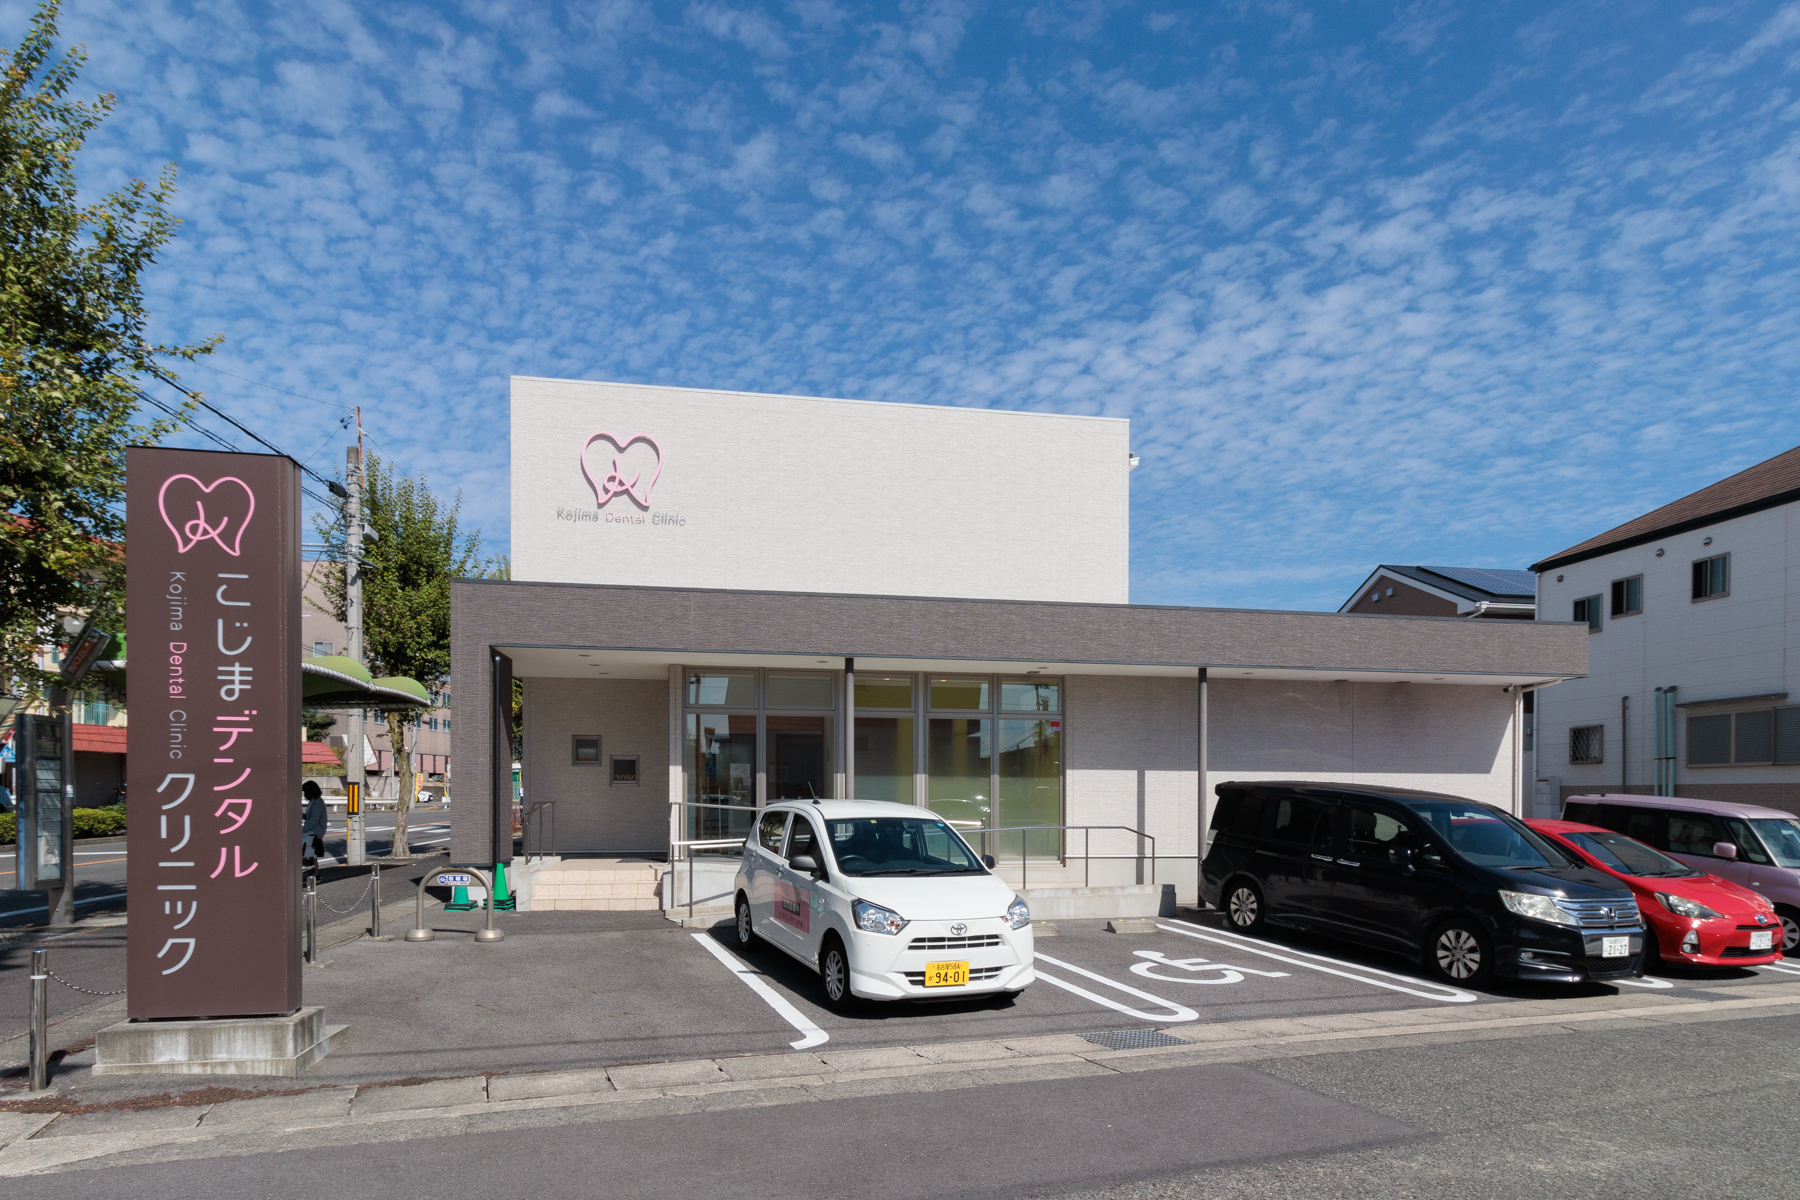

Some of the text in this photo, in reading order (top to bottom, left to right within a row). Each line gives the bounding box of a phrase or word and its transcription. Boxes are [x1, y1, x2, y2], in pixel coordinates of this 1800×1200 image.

[557, 507, 686, 526] Kojima Dental Clinic
[166, 571, 187, 759] Kojima Dental Clinic
[210, 573, 258, 879] こじまデンタル
[156, 773, 197, 975] クリニック
[935, 971, 965, 983] 94-01
[1608, 944, 1627, 955] 21-27
